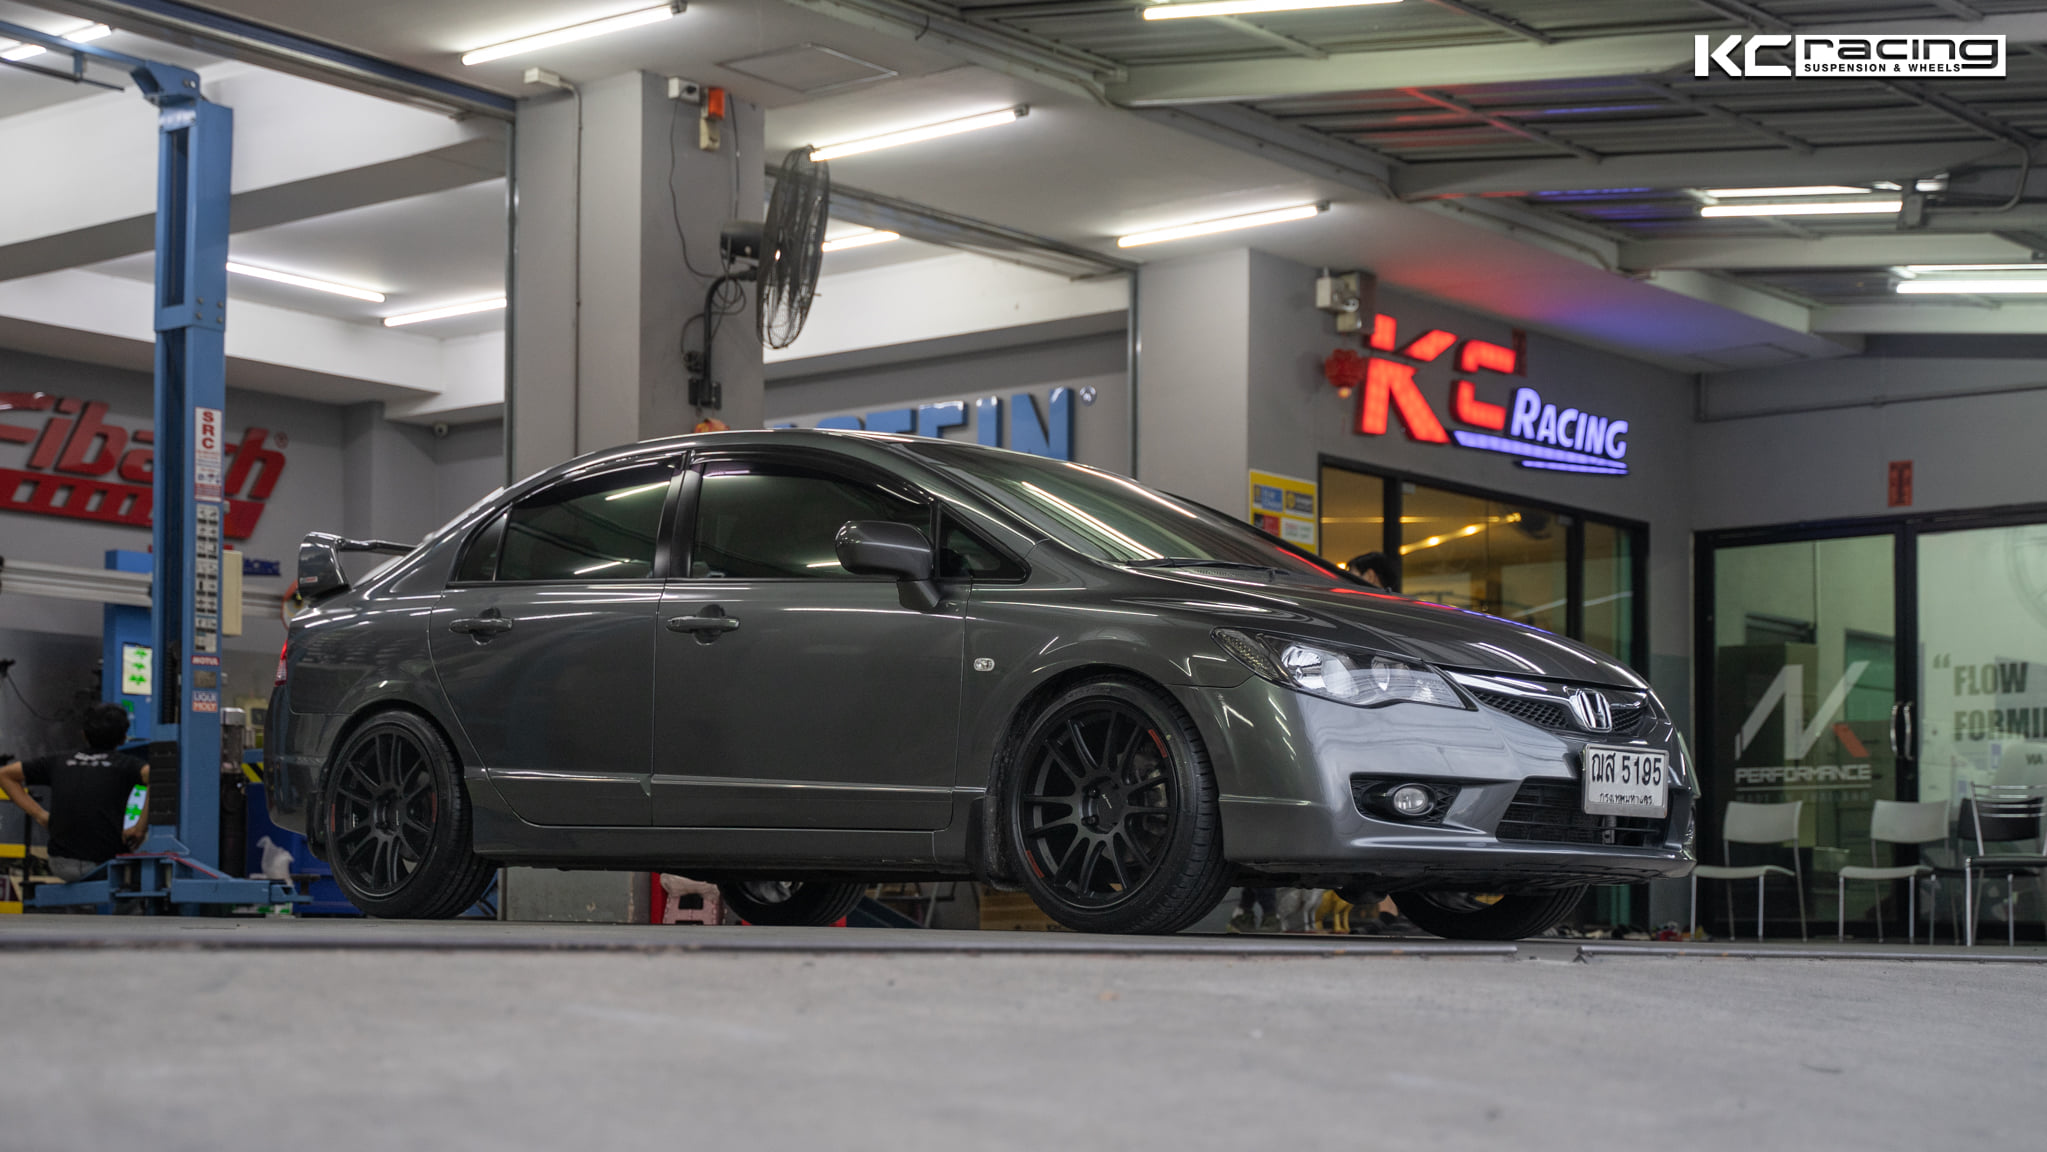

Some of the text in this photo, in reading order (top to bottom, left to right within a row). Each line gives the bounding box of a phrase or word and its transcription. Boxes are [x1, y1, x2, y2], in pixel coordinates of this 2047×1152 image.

[1361, 313, 1629, 460] KC RACING
[202, 411, 215, 449] SRC
[1954, 707, 2047, 741] FORMI
[1621, 755, 1662, 786] 5195
[1735, 764, 1872, 784] PERFORMANCE
